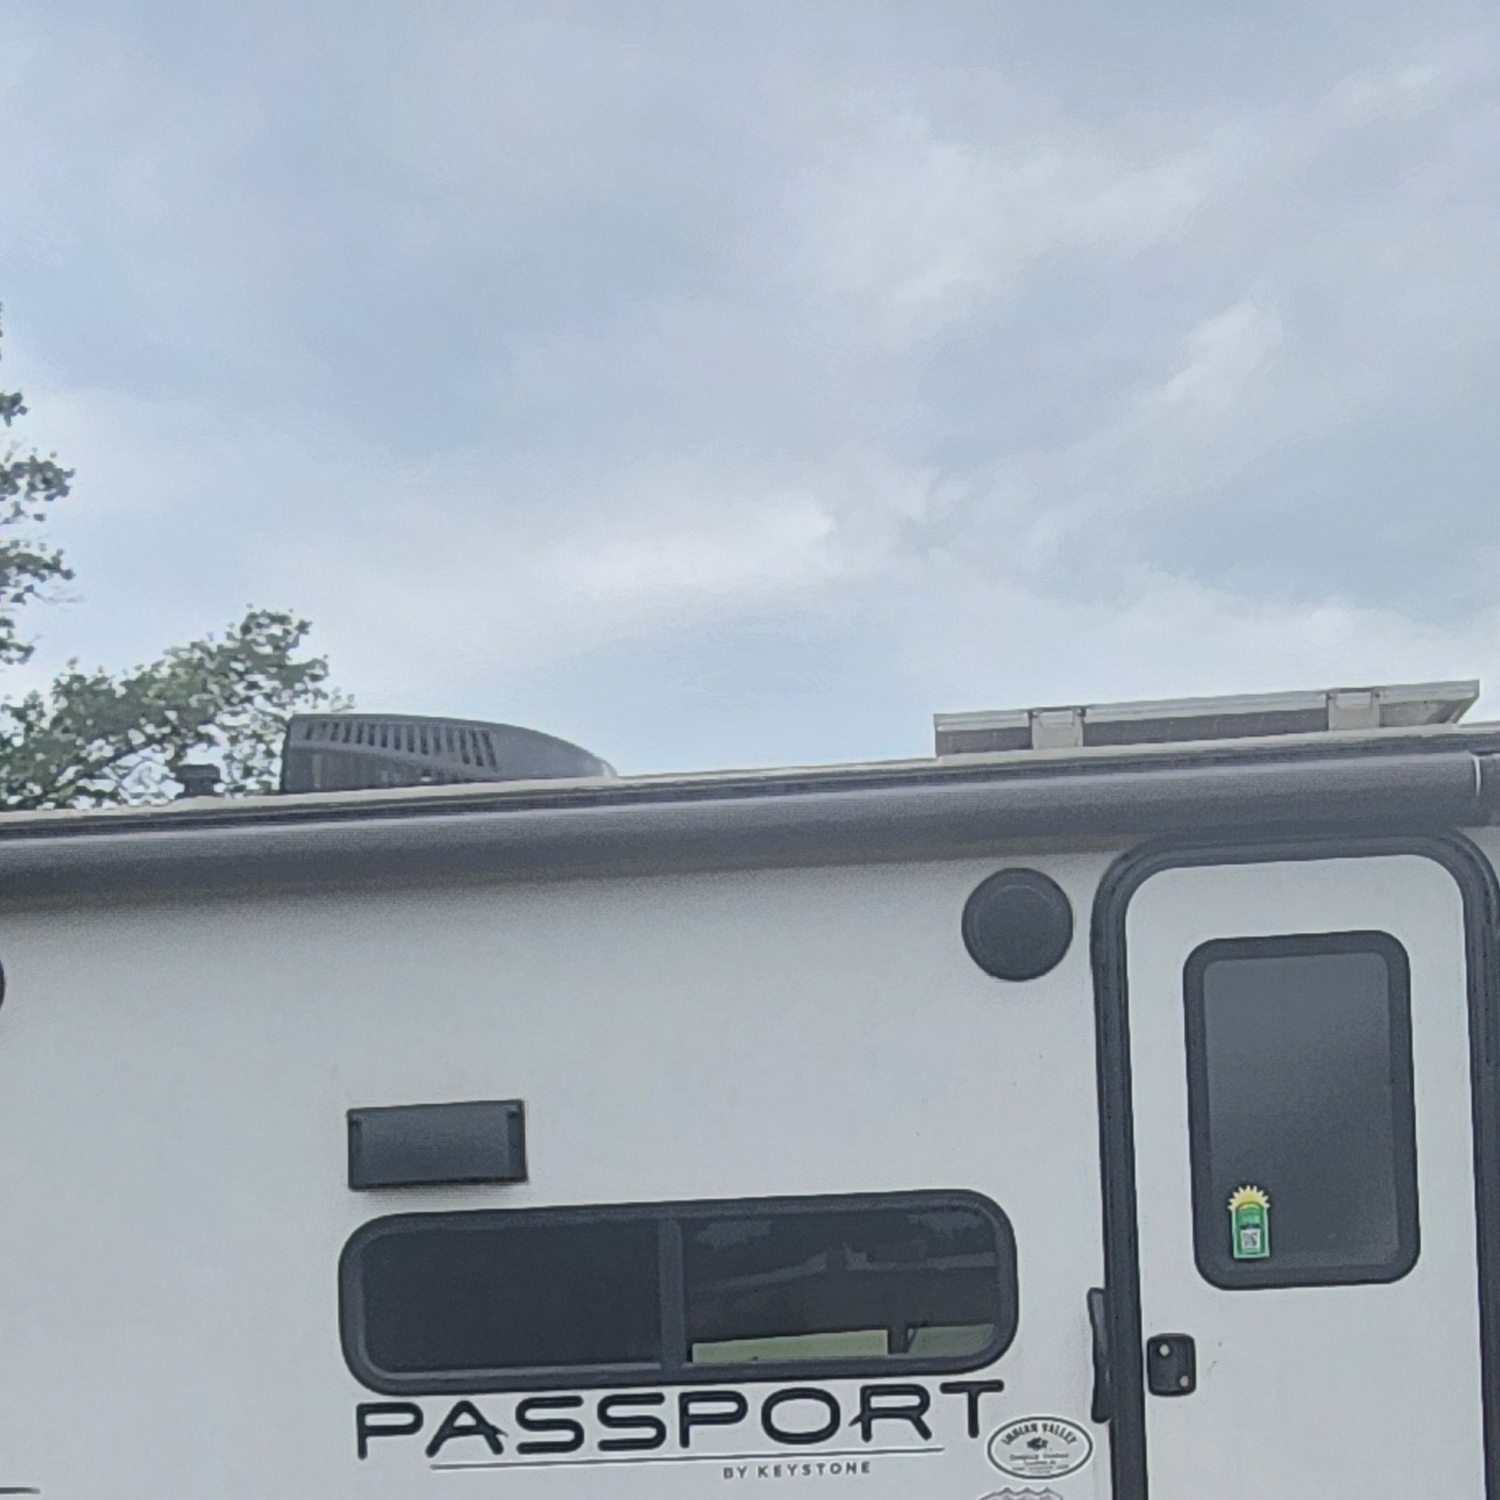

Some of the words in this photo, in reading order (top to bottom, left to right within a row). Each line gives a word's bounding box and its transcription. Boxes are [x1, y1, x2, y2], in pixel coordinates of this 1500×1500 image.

[357, 1379, 1005, 1460] PASSPORT
[723, 1465, 747, 1479] BY
[757, 1461, 870, 1478] KEYSTONE
